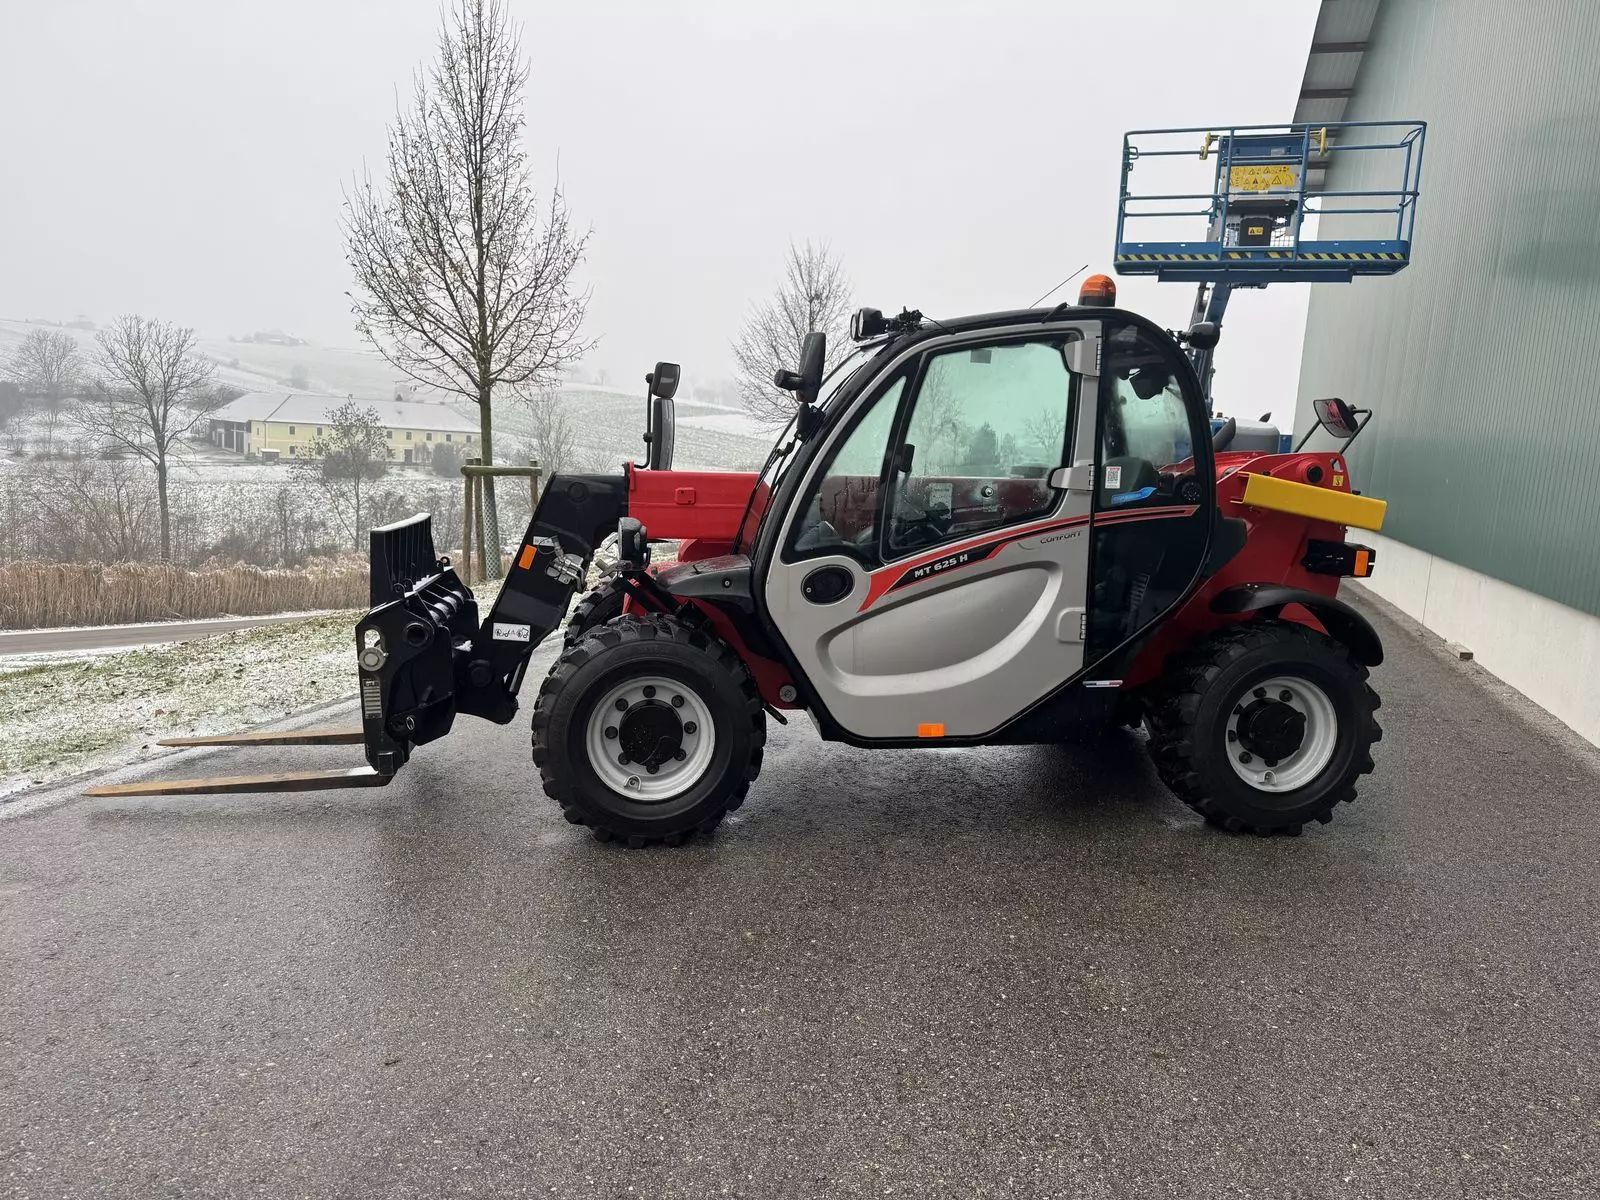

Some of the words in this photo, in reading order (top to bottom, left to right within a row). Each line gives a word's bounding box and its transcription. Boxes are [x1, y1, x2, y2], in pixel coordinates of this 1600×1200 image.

[914, 565, 932, 578] MT
[933, 557, 957, 571] 625
[959, 553, 968, 563] H
